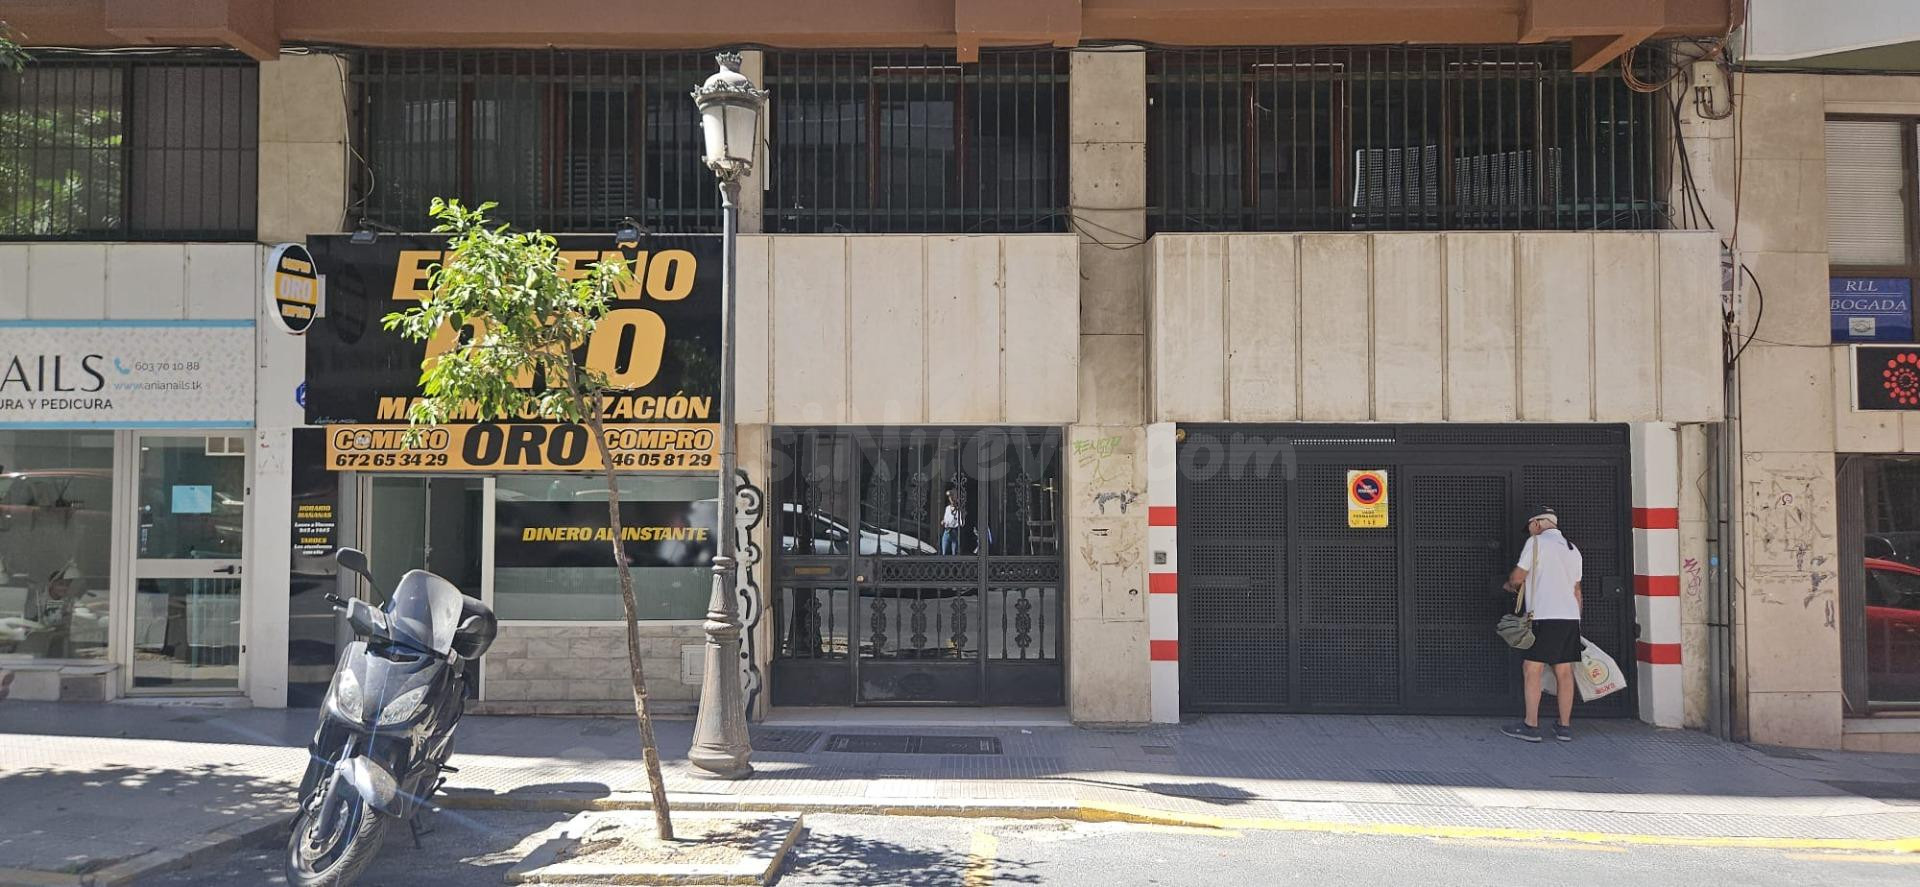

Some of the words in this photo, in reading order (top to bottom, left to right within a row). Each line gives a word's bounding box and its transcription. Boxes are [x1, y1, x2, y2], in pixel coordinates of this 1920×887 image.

[280, 274, 311, 303] ORO
[1845, 281, 1878, 292] RLL
[135, 361, 154, 372] 603
[157, 362, 170, 371] 70
[172, 362, 184, 371] 10
[186, 361, 200, 371] 88
[28, 399, 37, 410] Y
[41, 399, 113, 410] PEDICURA
[462, 424, 589, 467] ORO
[602, 428, 714, 451] COMPRO
[335, 453, 370, 467] 672
[373, 453, 396, 467] 65
[399, 453, 422, 467] 34
[424, 453, 449, 467] 29
[602, 453, 634, 466] 46
[637, 453, 660, 466] 05
[663, 453, 684, 466] 81
[688, 453, 712, 466] 29
[522, 527, 593, 541] DINERO
[620, 527, 710, 541] INSTANTE
